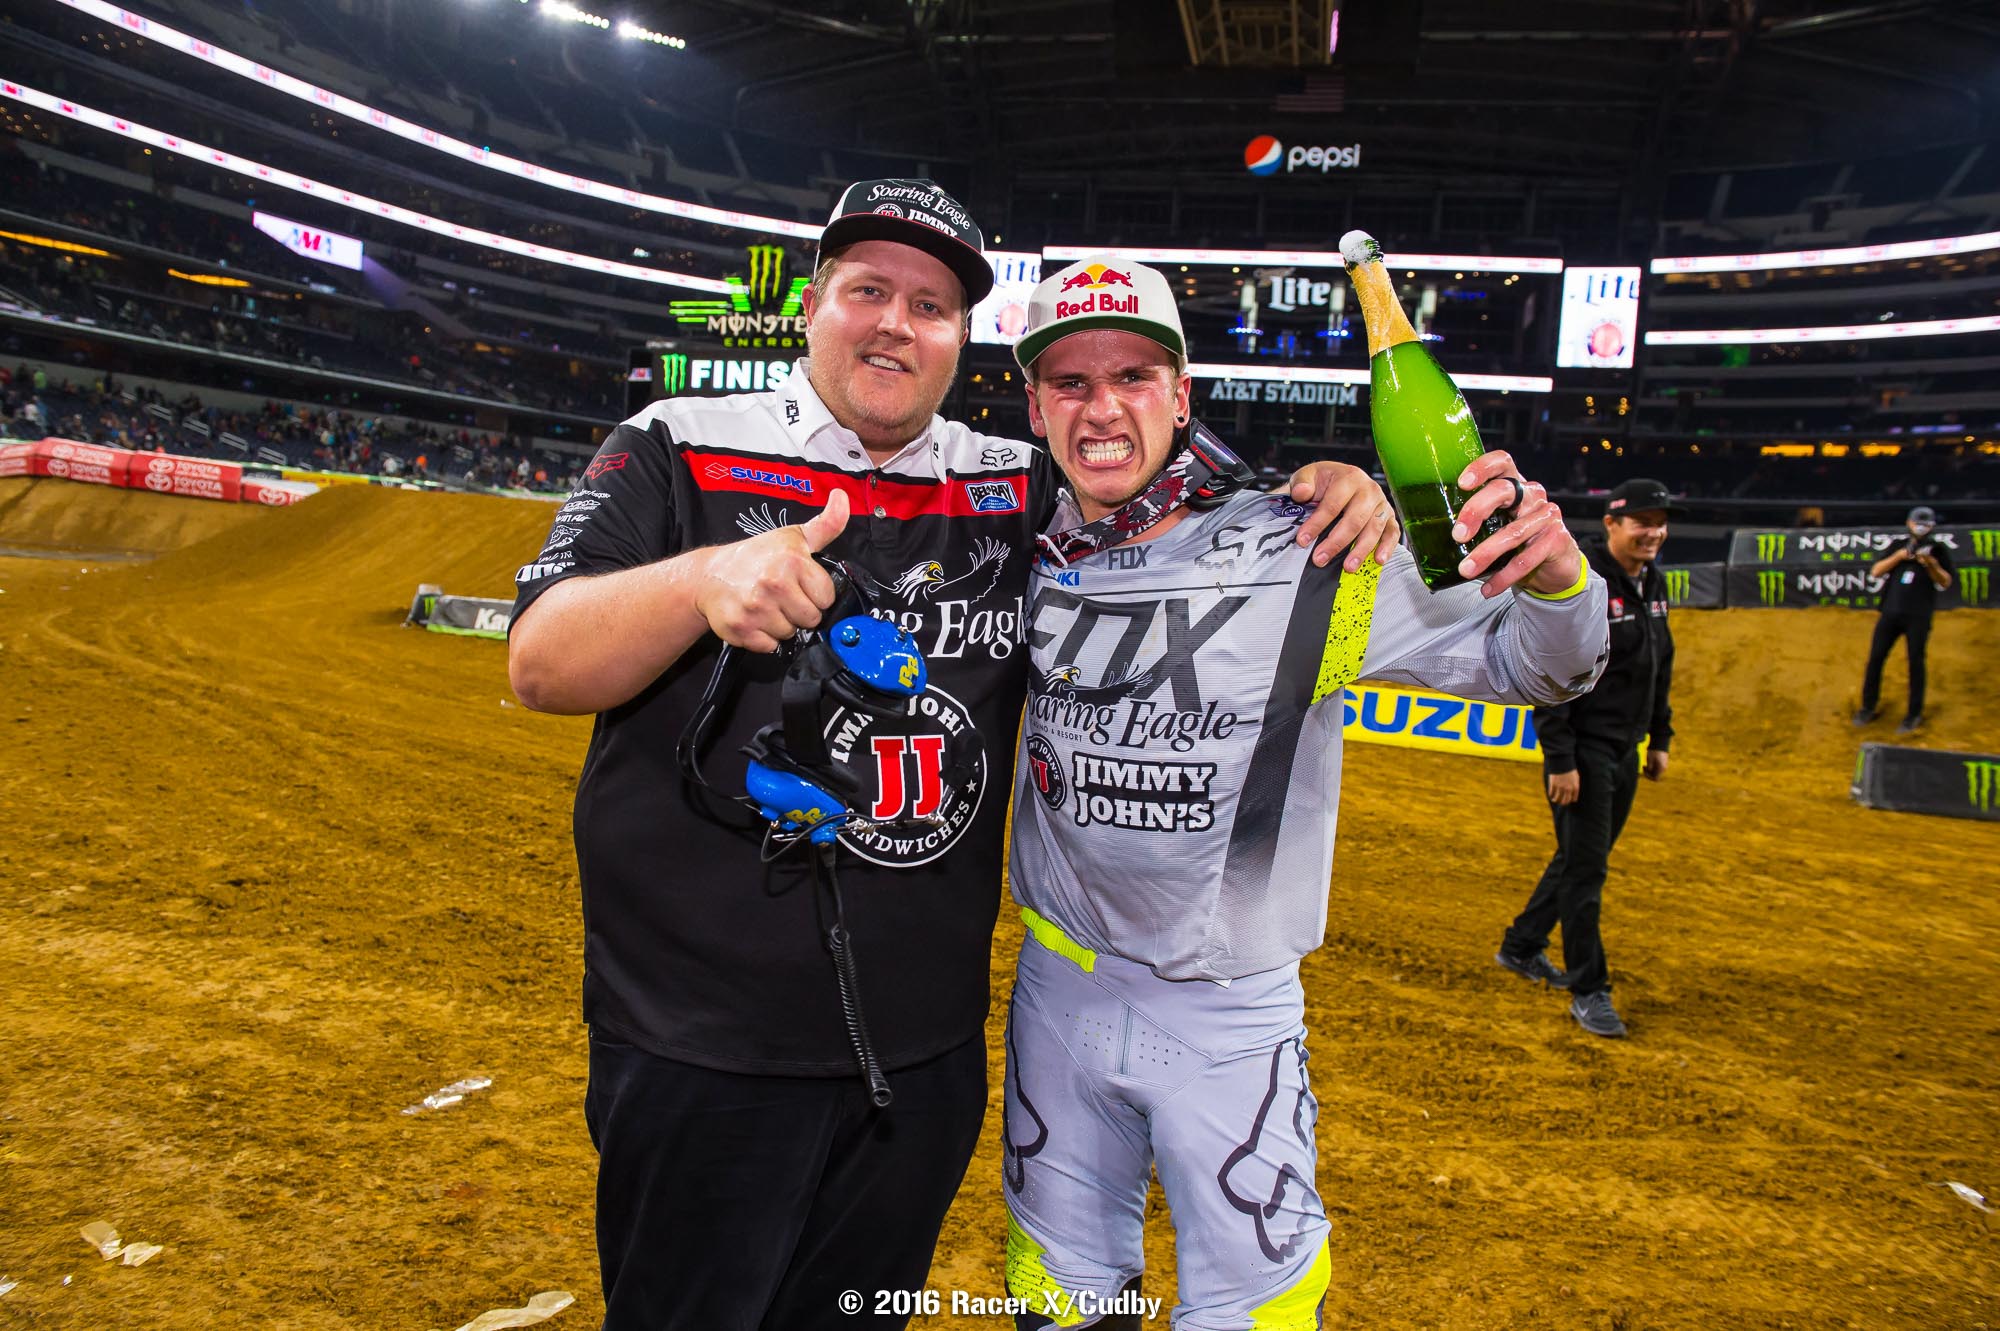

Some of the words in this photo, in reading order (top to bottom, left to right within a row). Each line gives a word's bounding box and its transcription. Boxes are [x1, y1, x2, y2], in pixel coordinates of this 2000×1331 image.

[1287, 144, 1361, 173] pepsi
[867, 184, 934, 208] Soaring
[932, 196, 970, 230] Eagle
[907, 209, 958, 238] JIMMY
[1056, 293, 1095, 320] Red
[1099, 293, 1139, 315] Bull
[1267, 276, 1331, 312] Lite
[707, 312, 808, 336] MONSTE
[691, 359, 790, 390] FINIS
[1210, 380, 1261, 401] AT&T
[1264, 382, 1358, 406] STADIUM
[174, 476, 223, 491] TOYOTA
[730, 467, 814, 492] SUZUKI
[1108, 545, 1152, 570] FOX
[1798, 570, 1890, 595] MONS
[927, 596, 1026, 659] Eagl
[1029, 586, 1251, 712] FOX
[907, 694, 965, 737] JOH
[1116, 700, 1239, 752] Eagle
[871, 734, 946, 820] JJ
[1074, 755, 1213, 792] JIMMY
[1076, 792, 1211, 830] JOHN'S
